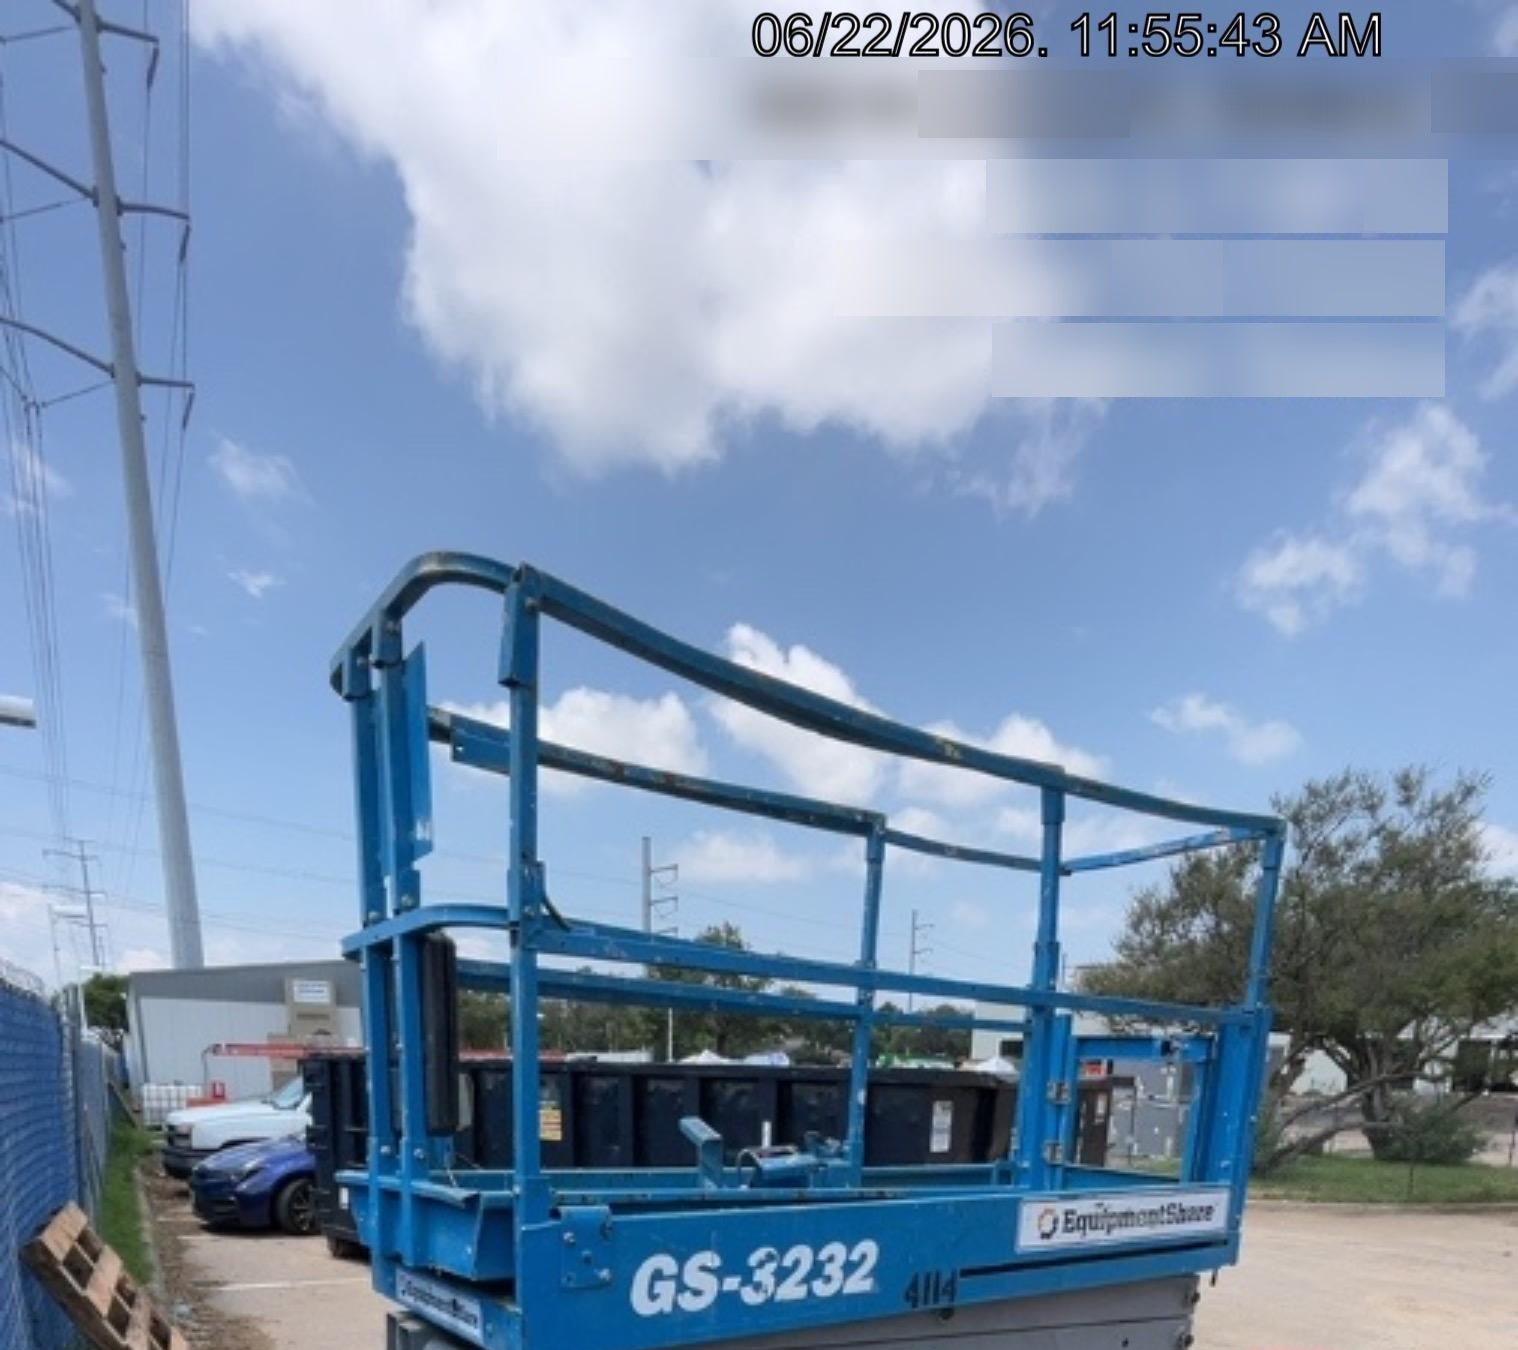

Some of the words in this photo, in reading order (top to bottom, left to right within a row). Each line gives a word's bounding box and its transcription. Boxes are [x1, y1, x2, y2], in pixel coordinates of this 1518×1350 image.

[1062, 1202, 1215, 1237] EquipmentShare
[630, 1239, 880, 1317] GS-3232
[904, 1269, 957, 1308] 4114
